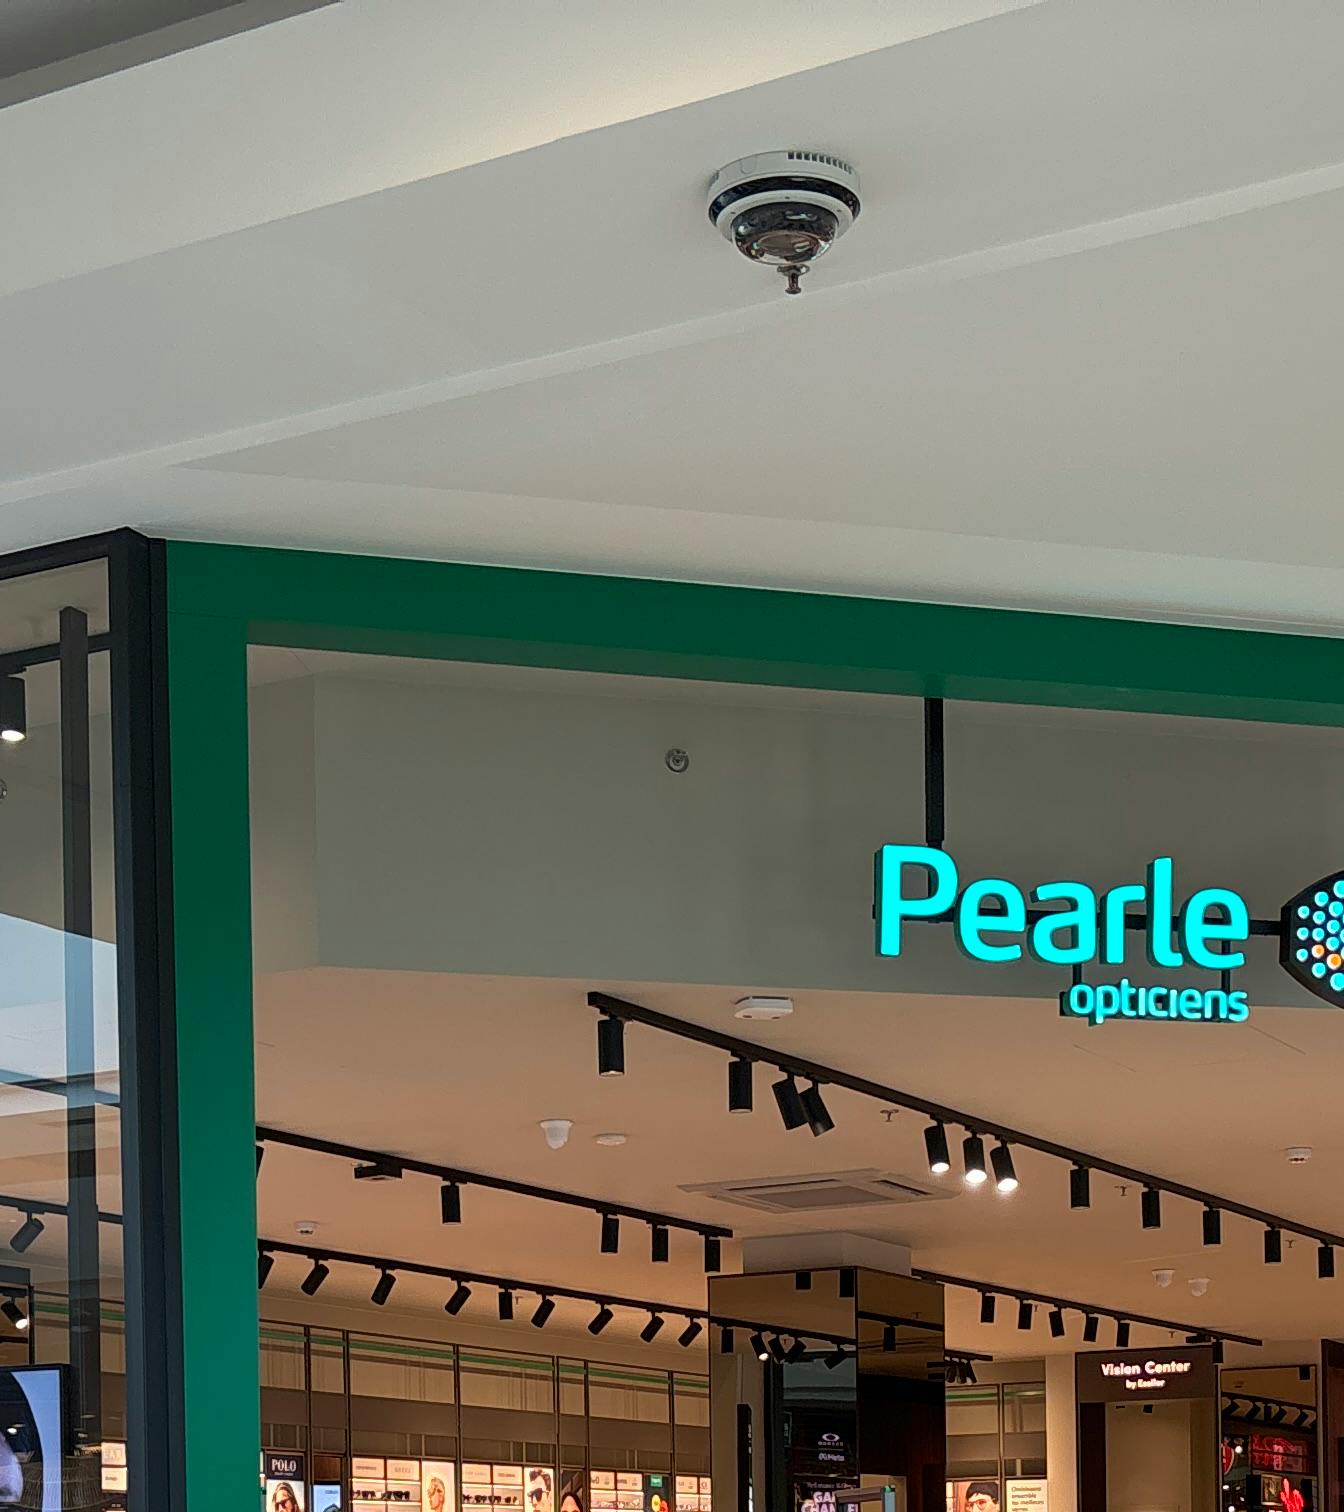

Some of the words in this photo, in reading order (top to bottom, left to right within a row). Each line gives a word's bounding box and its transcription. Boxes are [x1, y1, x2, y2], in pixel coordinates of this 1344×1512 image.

[875, 843, 1250, 969] Pearle
[1068, 978, 1250, 1025] opticiens
[1101, 1362, 1141, 1376] Vision
[1144, 1360, 1191, 1375] Center
[271, 1458, 297, 1472] POLO
